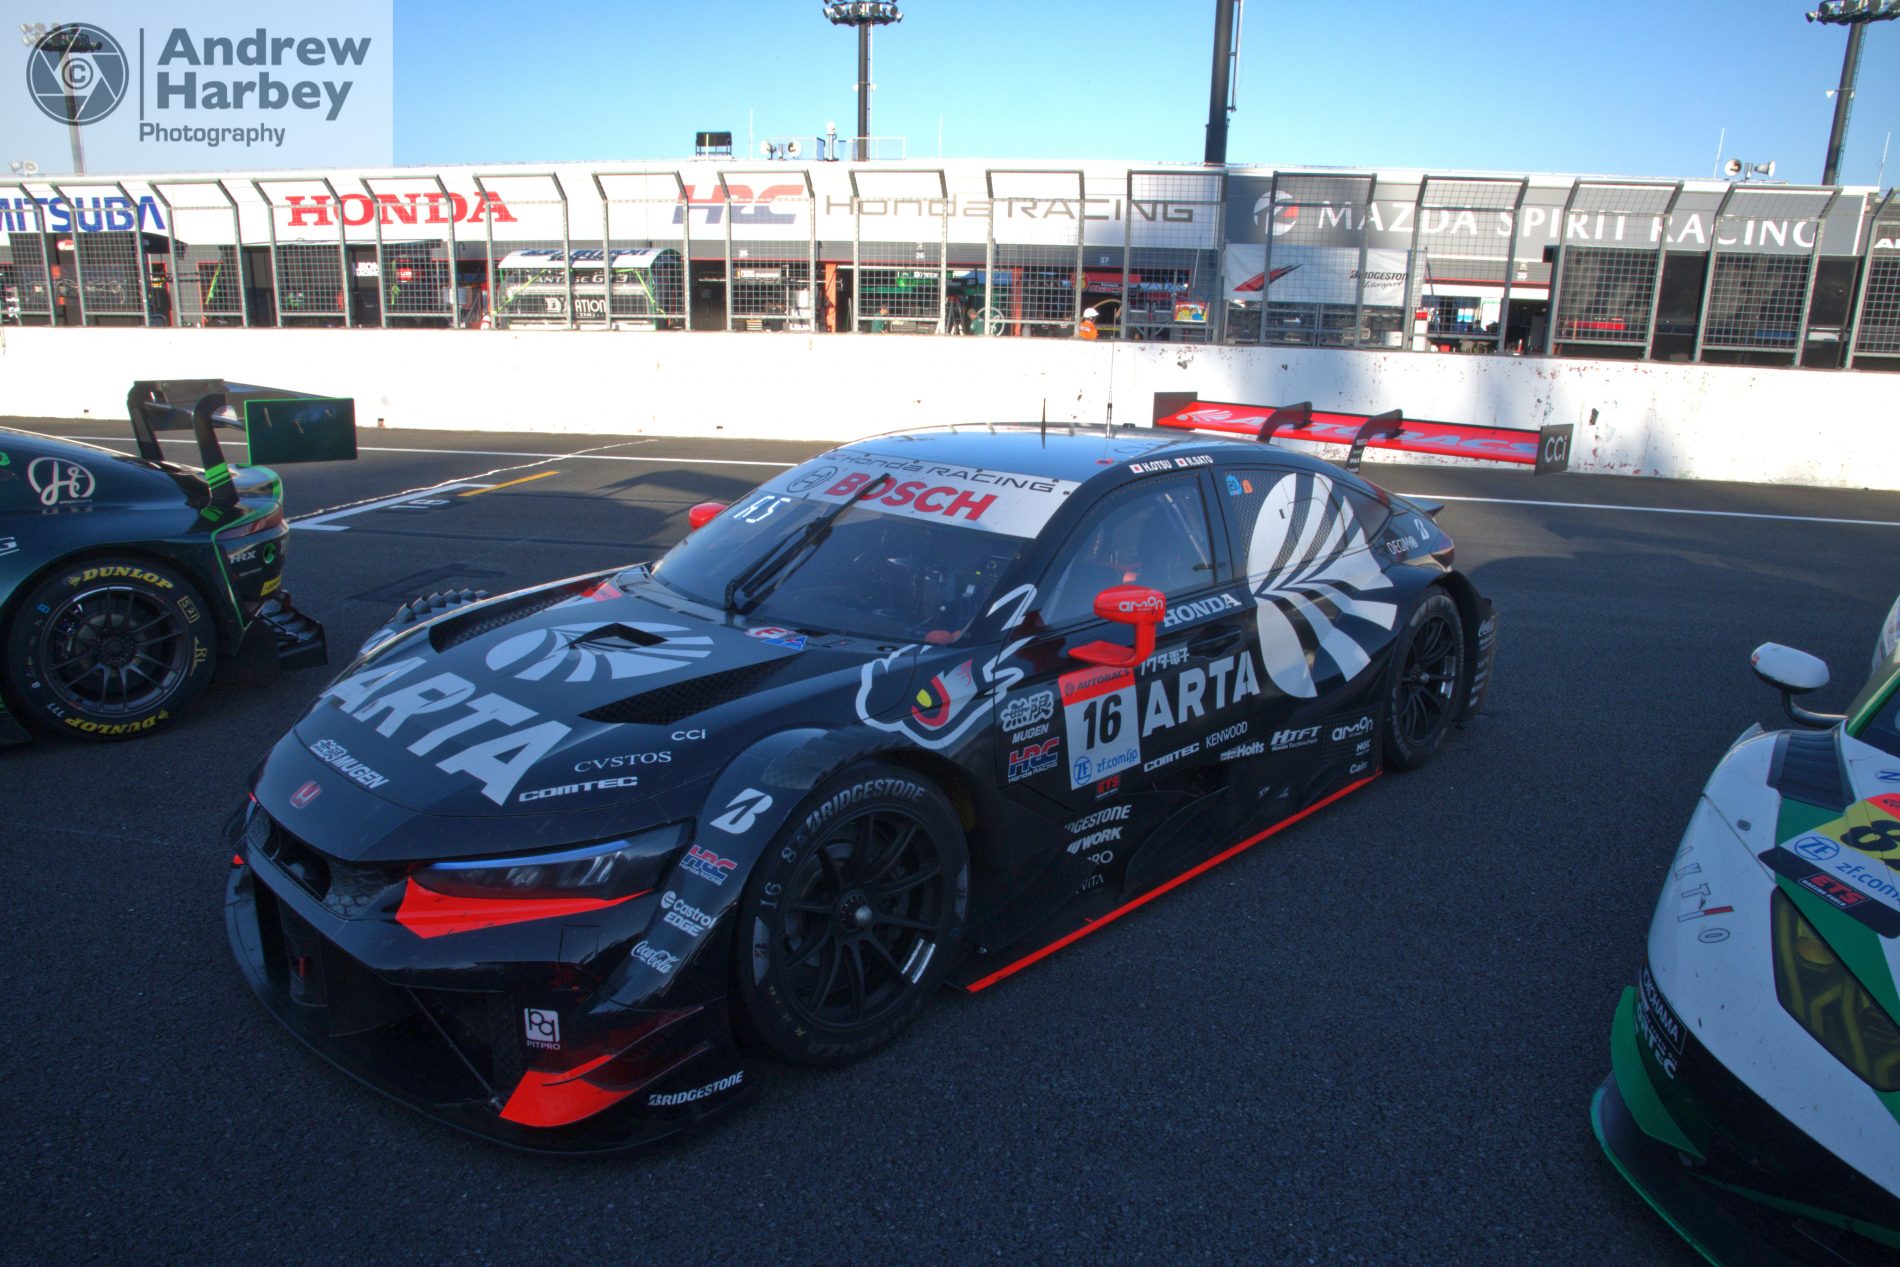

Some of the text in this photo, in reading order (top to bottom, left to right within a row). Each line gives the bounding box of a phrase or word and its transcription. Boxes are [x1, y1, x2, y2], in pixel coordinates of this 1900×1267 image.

[285, 191, 518, 227] HONDA
[671, 184, 805, 225] HRC
[826, 193, 1194, 223] Honda RACING
[1318, 200, 1817, 249] MAZDA SPIRIT RACING
[840, 453, 923, 473] Honda
[924, 466, 1056, 493] RACING
[1141, 459, 1173, 472] H.OTSU
[1185, 454, 1214, 466] R.SATO
[824, 472, 998, 521] BOSCH
[82, 566, 174, 590] DUNLOP
[1163, 593, 1242, 628] HONDA
[1076, 668, 1130, 691] AUTOBACS
[1142, 650, 1261, 738] ARTA
[64, 716, 160, 735] DUNLOP
[318, 656, 573, 806] ARTA
[1011, 722, 1050, 744] MUGEN
[1083, 693, 1122, 751] 16
[1206, 721, 1248, 748] KENWOOD
[1270, 725, 1323, 746] HTFT
[574, 751, 673, 773] CVSTOS
[1008, 736, 1060, 778] HRC
[1074, 748, 1138, 783] ZF zf.com/jp
[1143, 741, 1200, 772] COMTEC
[1237, 741, 1265, 758] Holts
[332, 754, 390, 789] MUGEN
[519, 776, 638, 802] COMTEC
[804, 778, 926, 832] BRIDGESTONE
[1080, 826, 1123, 850] WORK
[1839, 819, 1900, 872] 8
[681, 844, 738, 881] HRC
[1795, 836, 1900, 903] ZF zf.com
[1809, 872, 1866, 904] ETS
[663, 911, 706, 937] EDGE
[673, 898, 718, 929] Castrol
[526, 1040, 561, 1050] PITPRO
[648, 1070, 744, 1106] BRIDGESTONE
